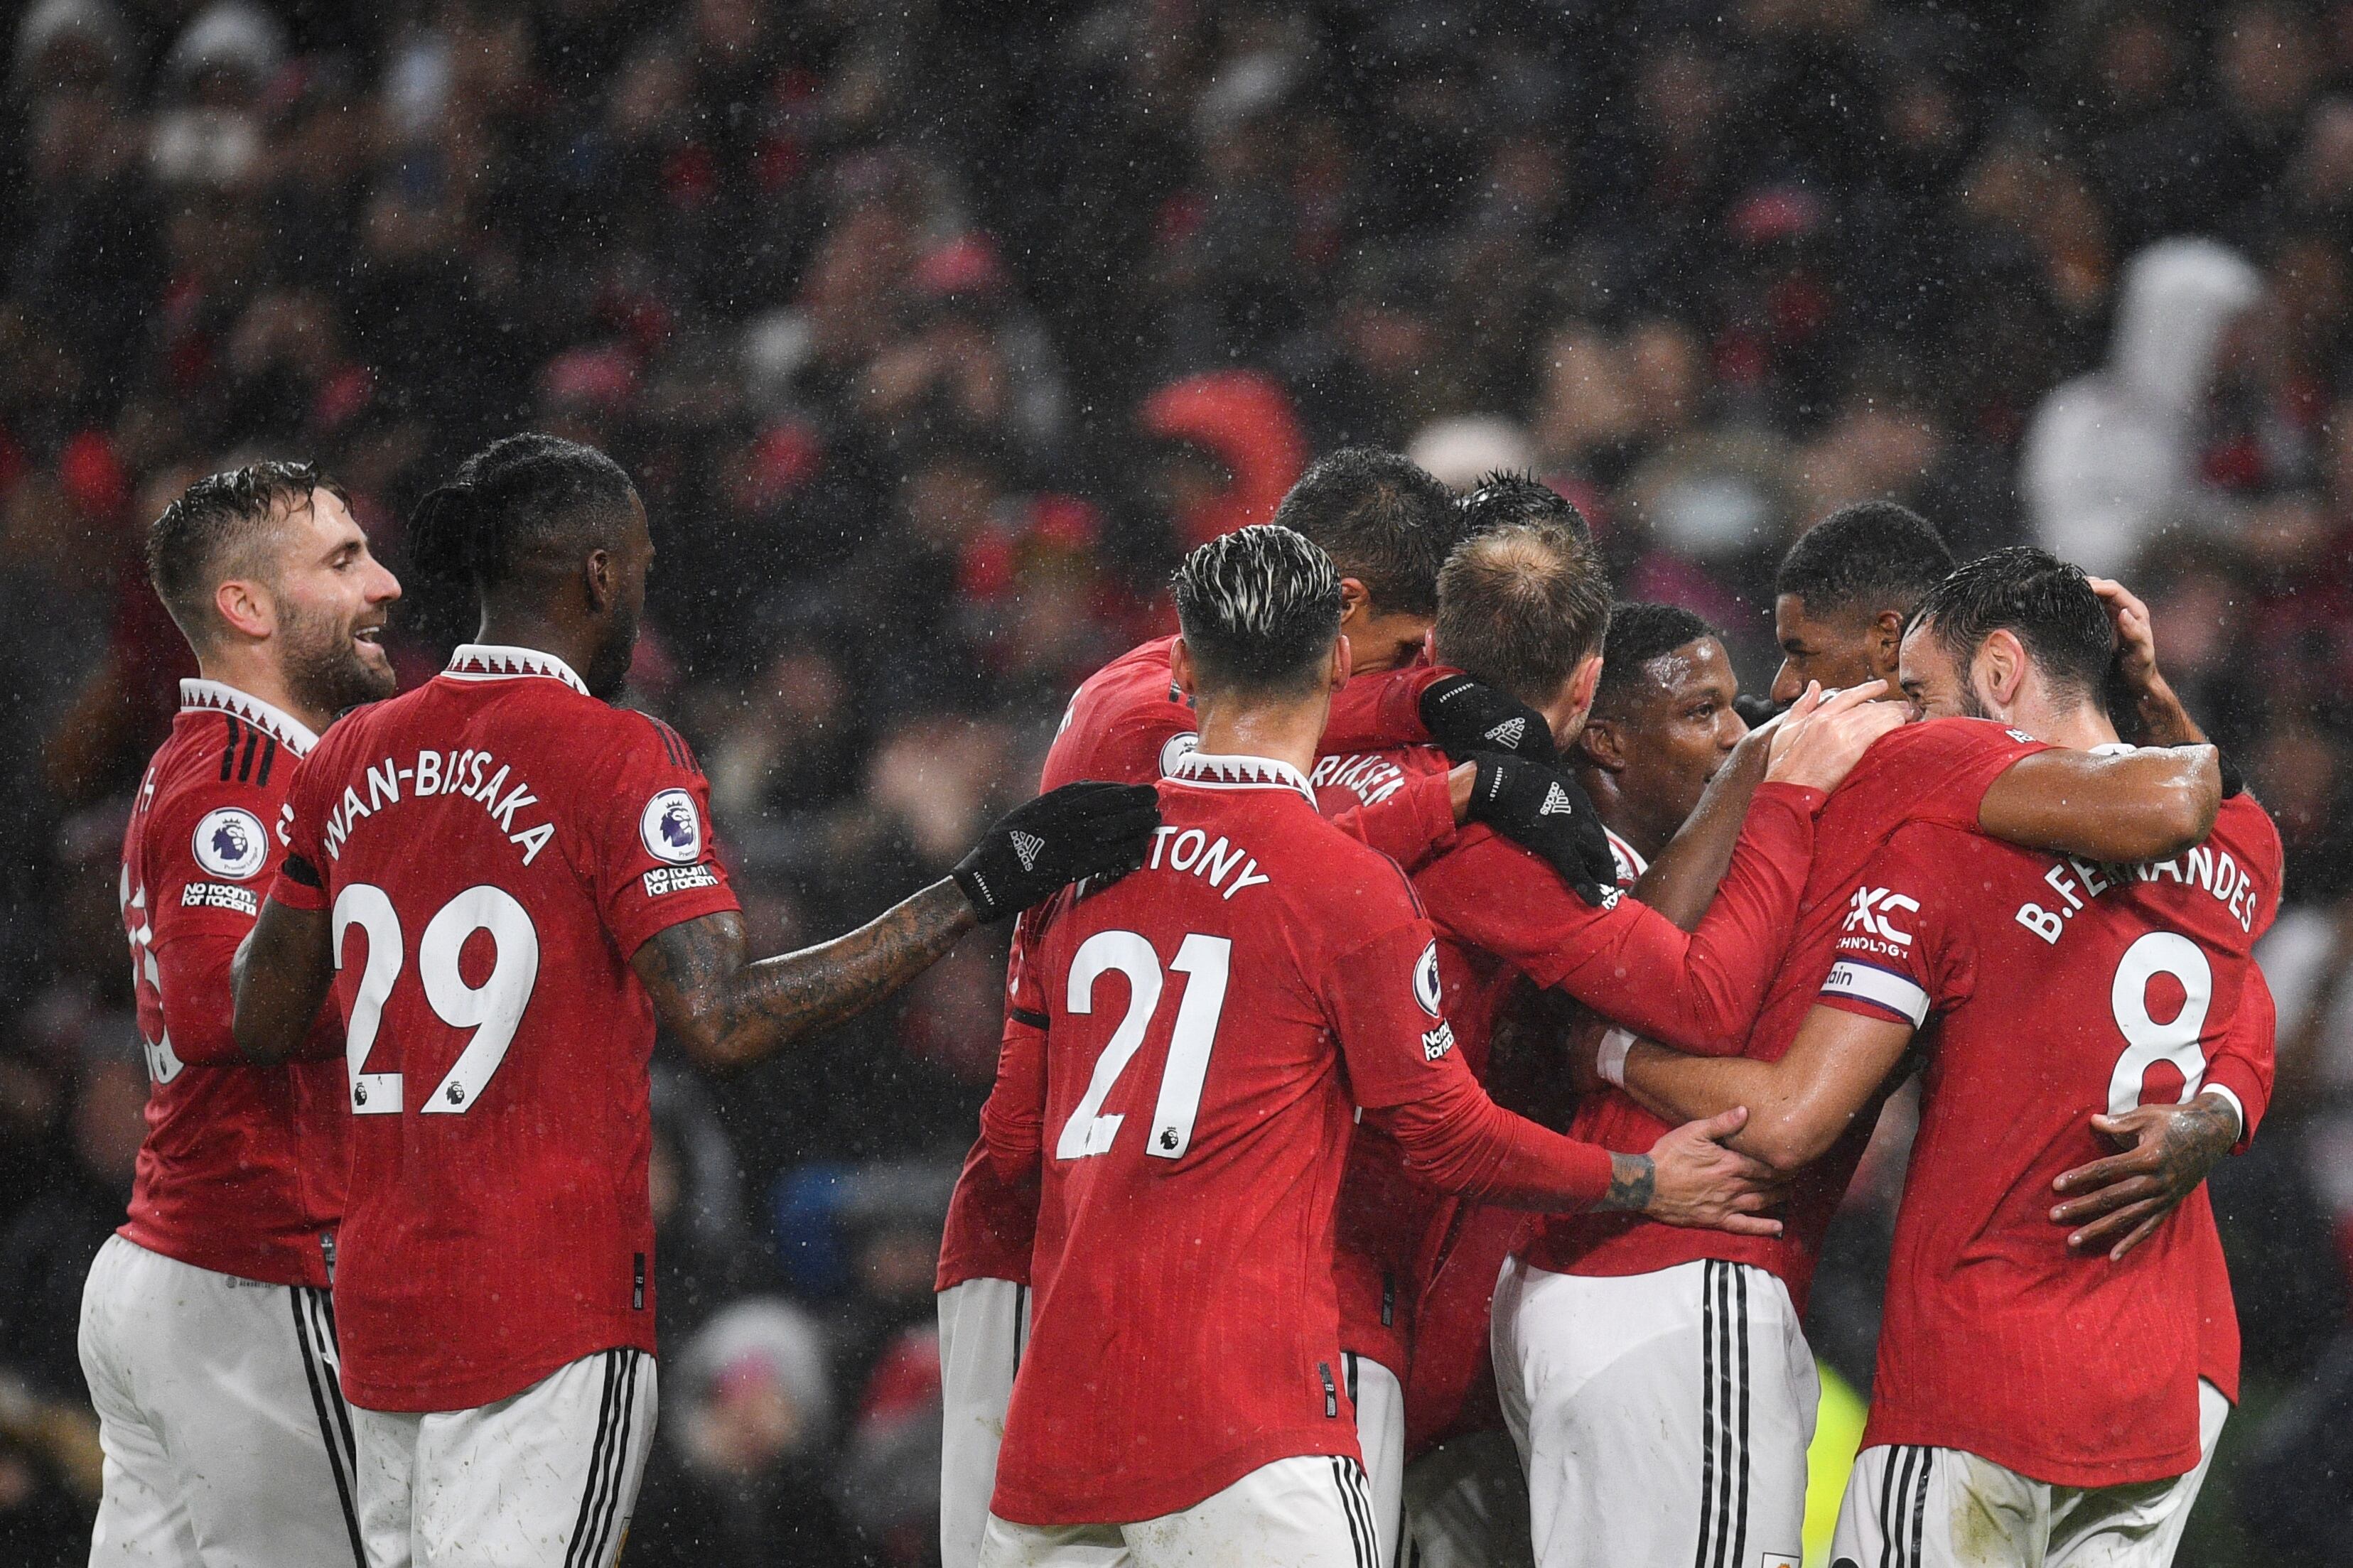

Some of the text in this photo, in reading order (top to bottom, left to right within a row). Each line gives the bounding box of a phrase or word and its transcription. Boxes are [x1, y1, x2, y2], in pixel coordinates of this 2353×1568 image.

[1485, 717, 1526, 740] adidas
[323, 748, 556, 867] WAN-BISSAKA
[1308, 754, 1405, 807] RIKSEN
[1539, 781, 1560, 816] adidas
[1009, 830, 1034, 872] adidas
[1076, 826, 1270, 901] TONY
[331, 882, 541, 1115] 29
[1824, 965, 1853, 986] ain
[1055, 929, 1233, 1160] 21
[2107, 930, 2213, 1116] 8
